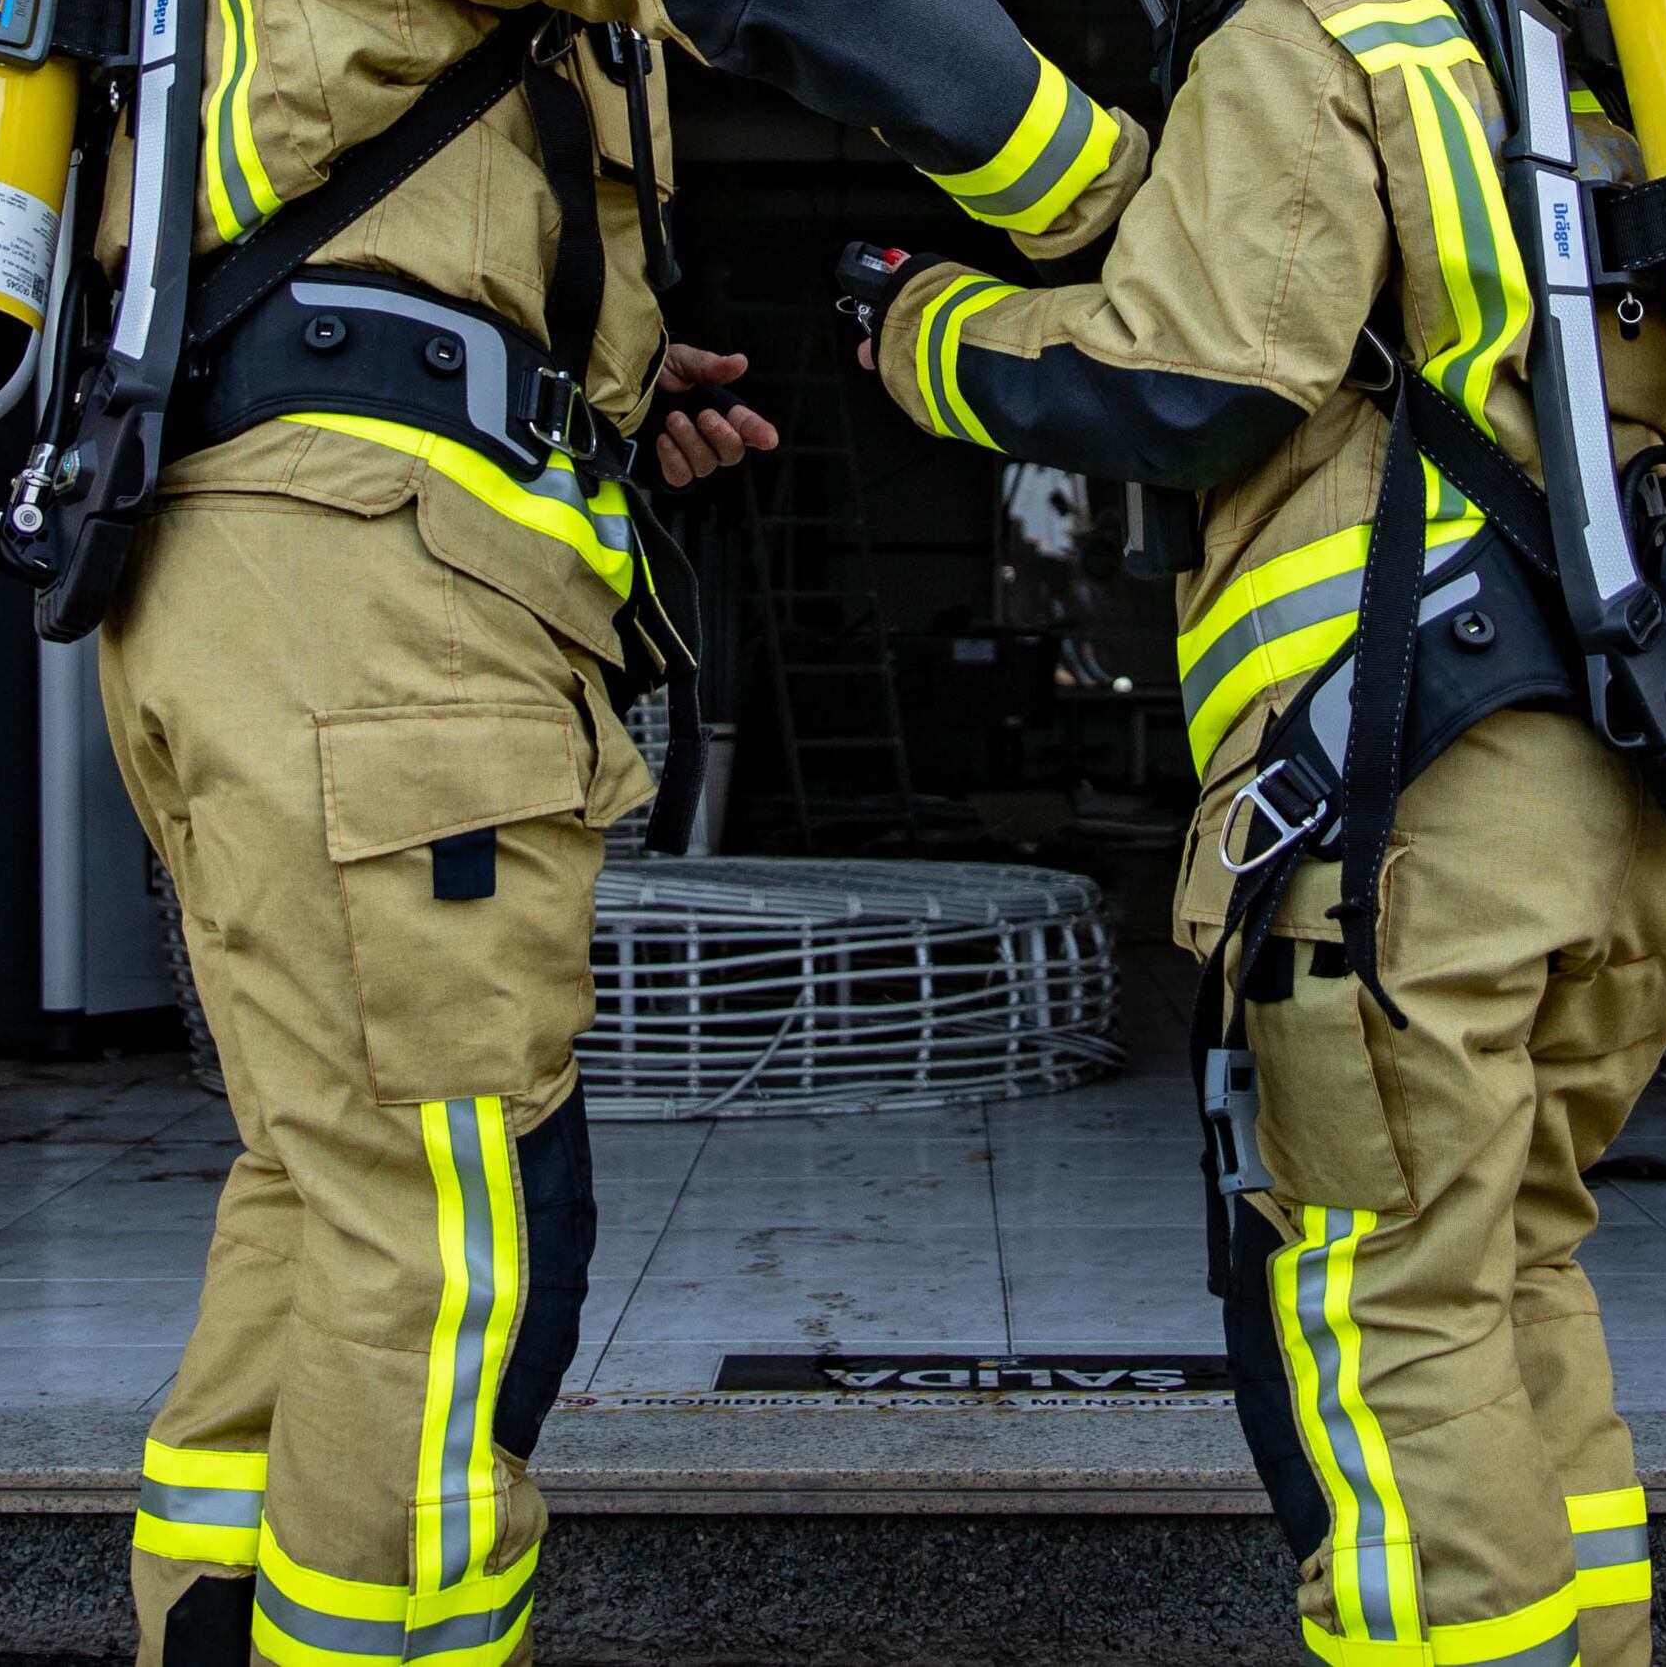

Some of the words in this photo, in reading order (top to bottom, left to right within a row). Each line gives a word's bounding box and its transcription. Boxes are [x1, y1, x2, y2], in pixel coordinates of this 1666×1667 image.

[1553, 203, 1570, 259] Dräger
[824, 1368, 1187, 1390] SALIDA
[620, 1397, 821, 1406] PROHIBIDO
[834, 1397, 879, 1406] EL
[889, 1397, 984, 1406] PASO
[995, 1398, 1018, 1406] A
[1031, 1397, 1210, 1406] MENORES
